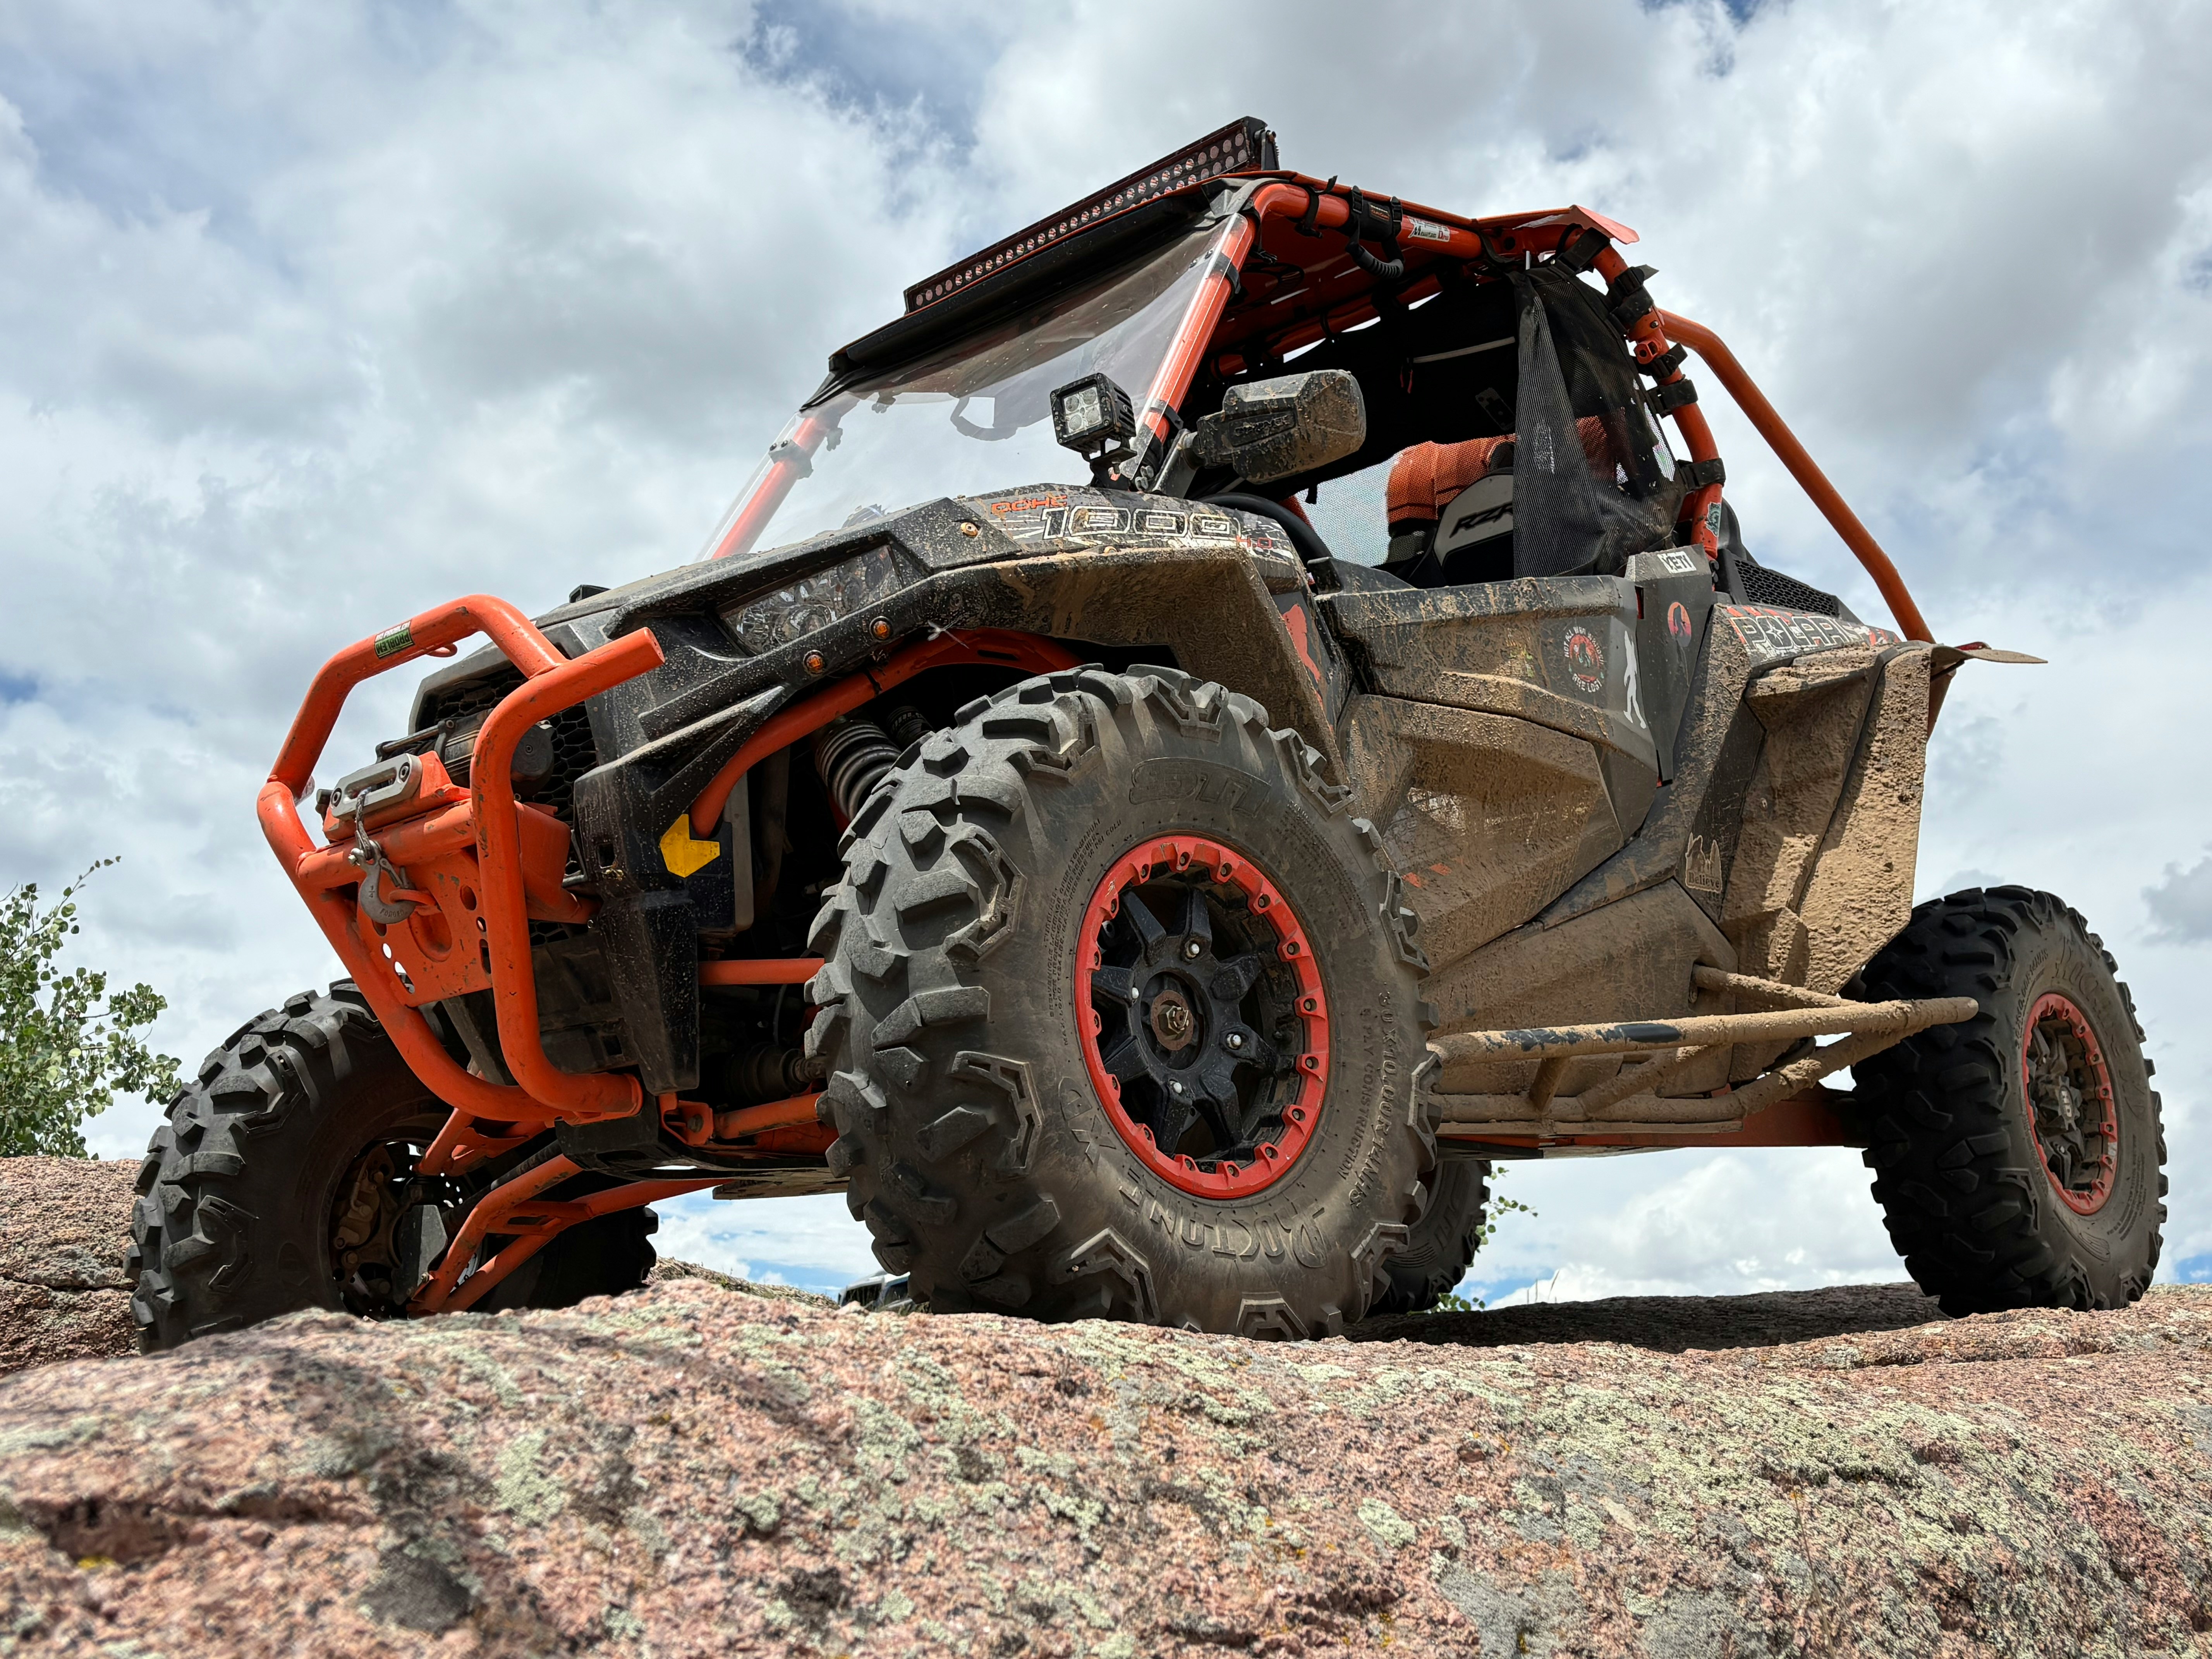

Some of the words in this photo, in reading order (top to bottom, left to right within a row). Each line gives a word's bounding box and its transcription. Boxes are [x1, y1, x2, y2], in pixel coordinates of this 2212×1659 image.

[1041, 505, 1241, 539] 1000
[1661, 555, 1692, 570] YETI
[1565, 629, 1574, 642] ALL
[1587, 678, 1602, 693] LOST
[1688, 871, 1720, 888] Believe
[1337, 1061, 1374, 1181] CONSTRUCTION
